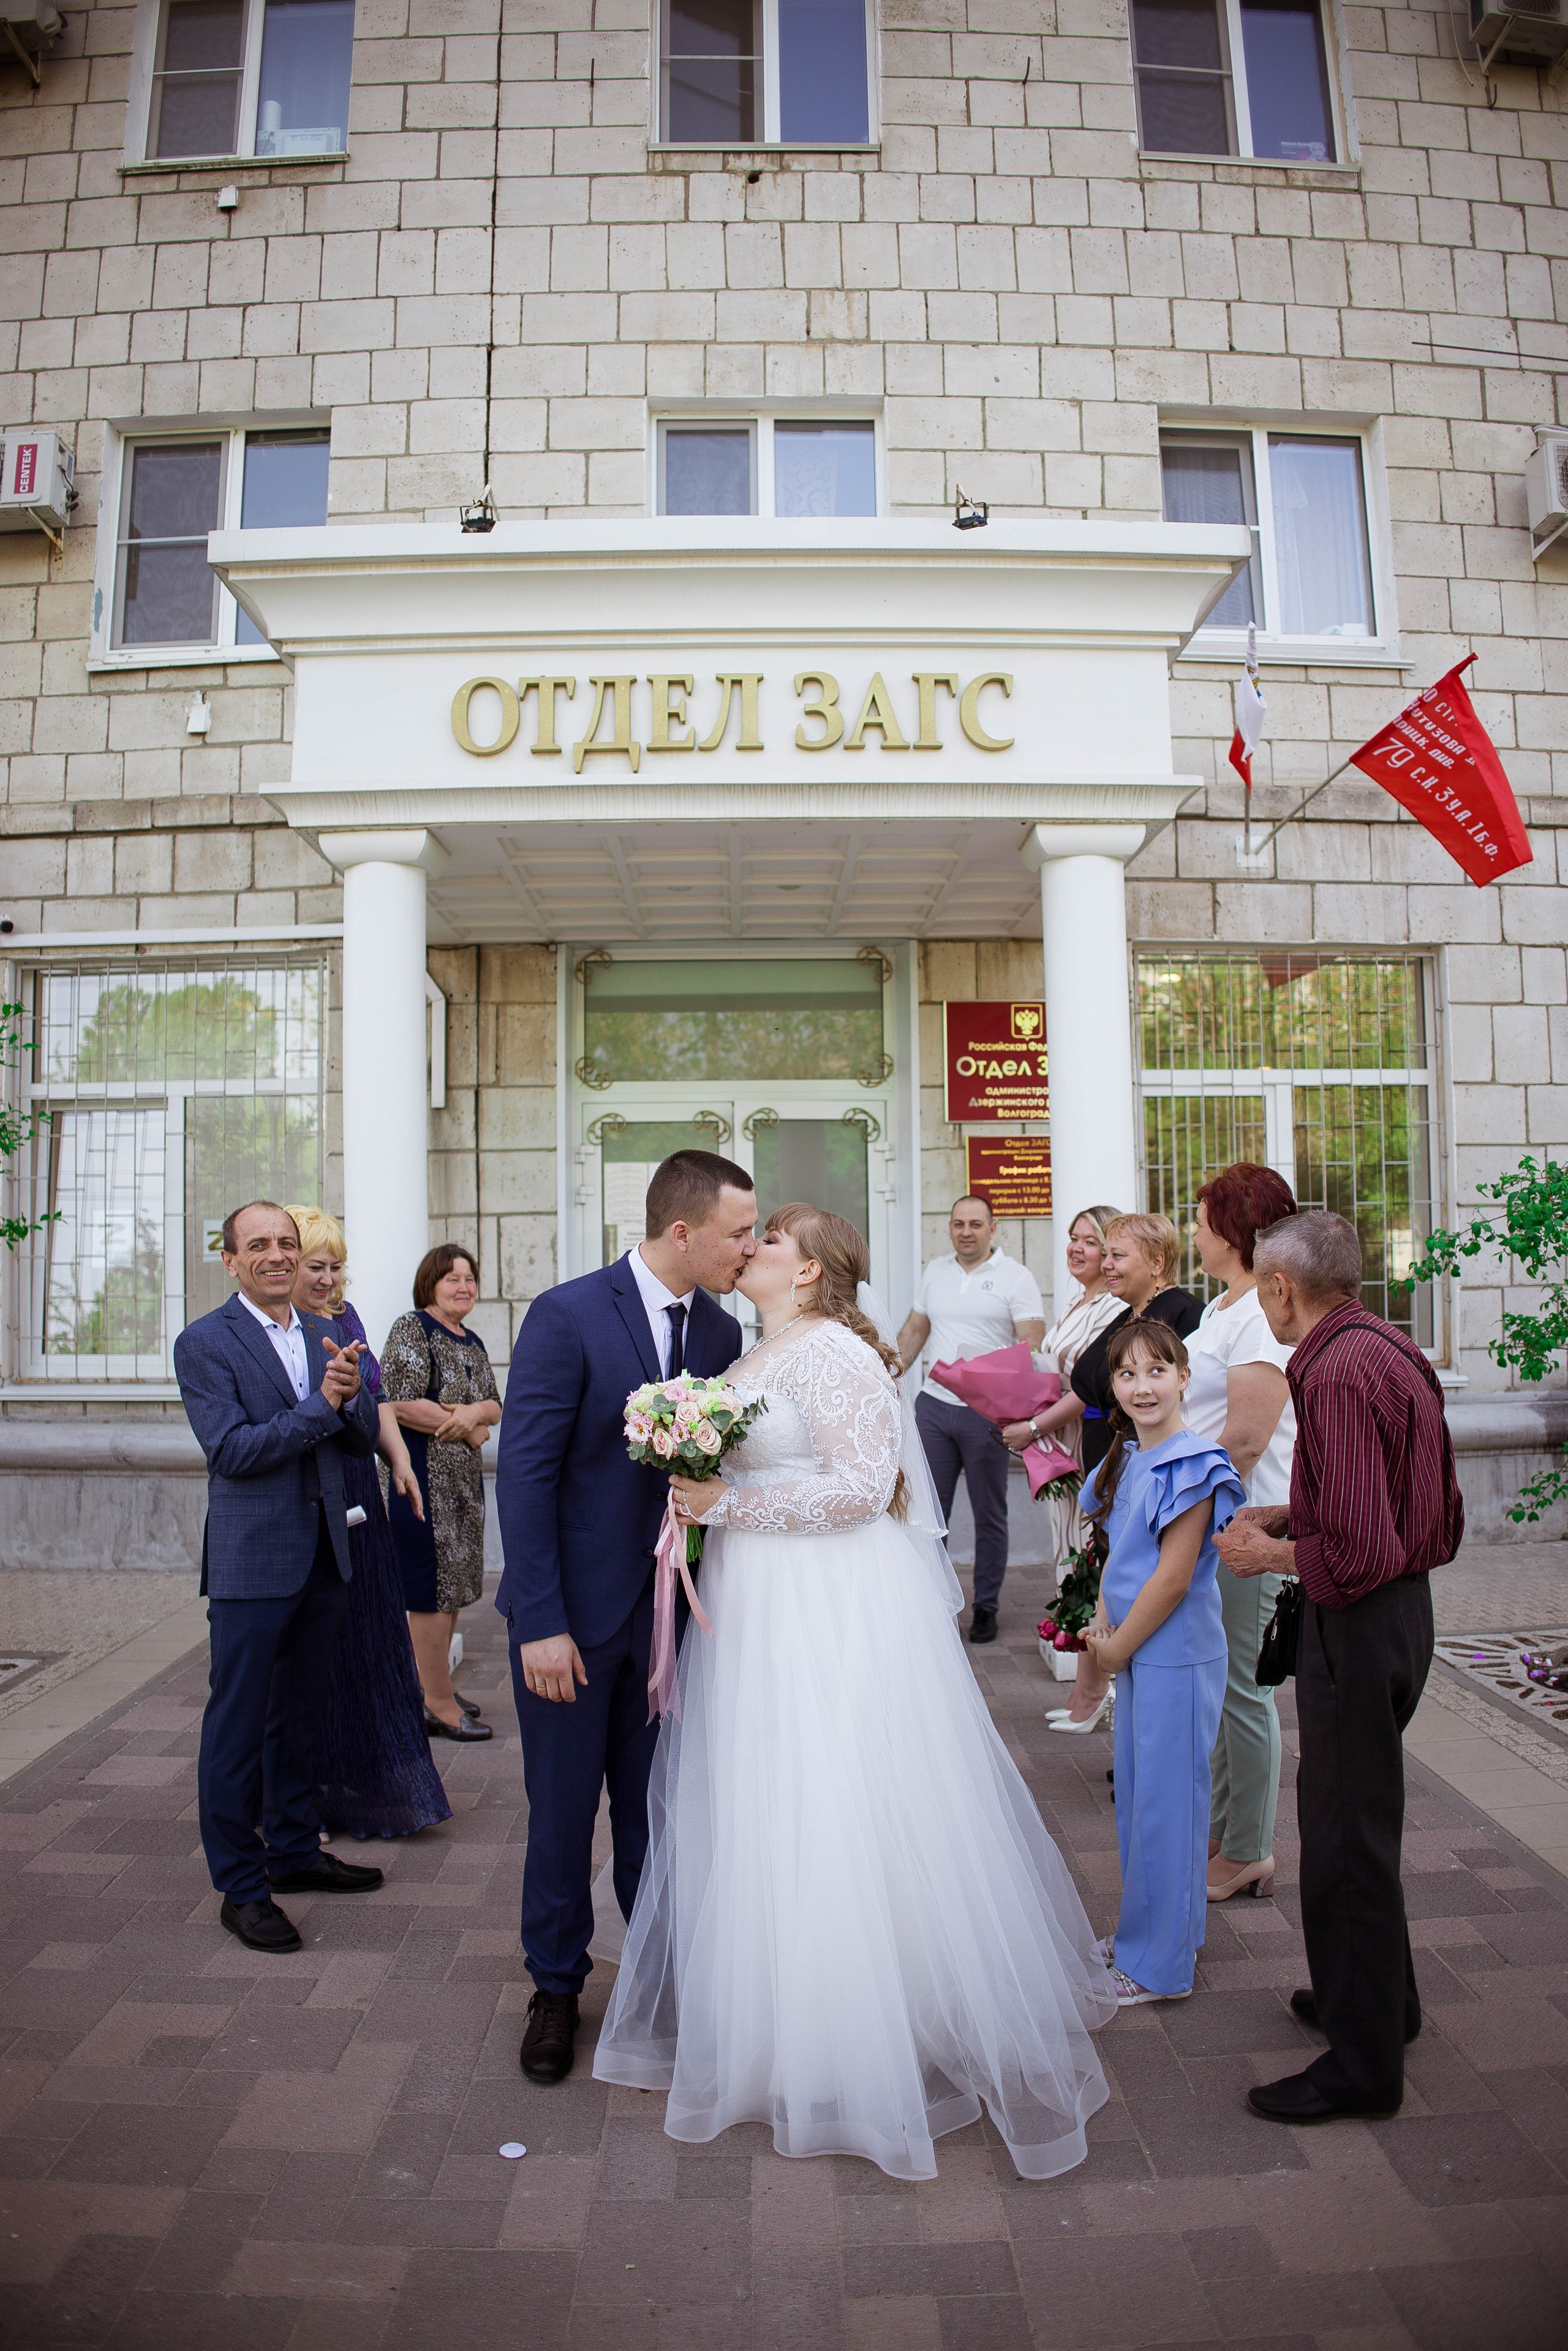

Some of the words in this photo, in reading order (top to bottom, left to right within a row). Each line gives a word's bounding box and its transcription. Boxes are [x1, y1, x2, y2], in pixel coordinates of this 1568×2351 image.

[19, 448, 32, 493] CENTEK
[1423, 685, 1438, 703] 0
[450, 673, 765, 774] ОТДЕЛ
[794, 670, 1016, 752] ЗАГС
[1373, 737, 1415, 769] 79
[968, 1041, 1027, 1051] Российская
[1028, 1041, 1048, 1052] Фед
[956, 1055, 1033, 1079] Отдел
[1036, 1055, 1049, 1076] З
[985, 1087, 1049, 1096] администра
[997, 1108, 1050, 1119] Волгоград
[1027, 1164, 1052, 1176] работ
